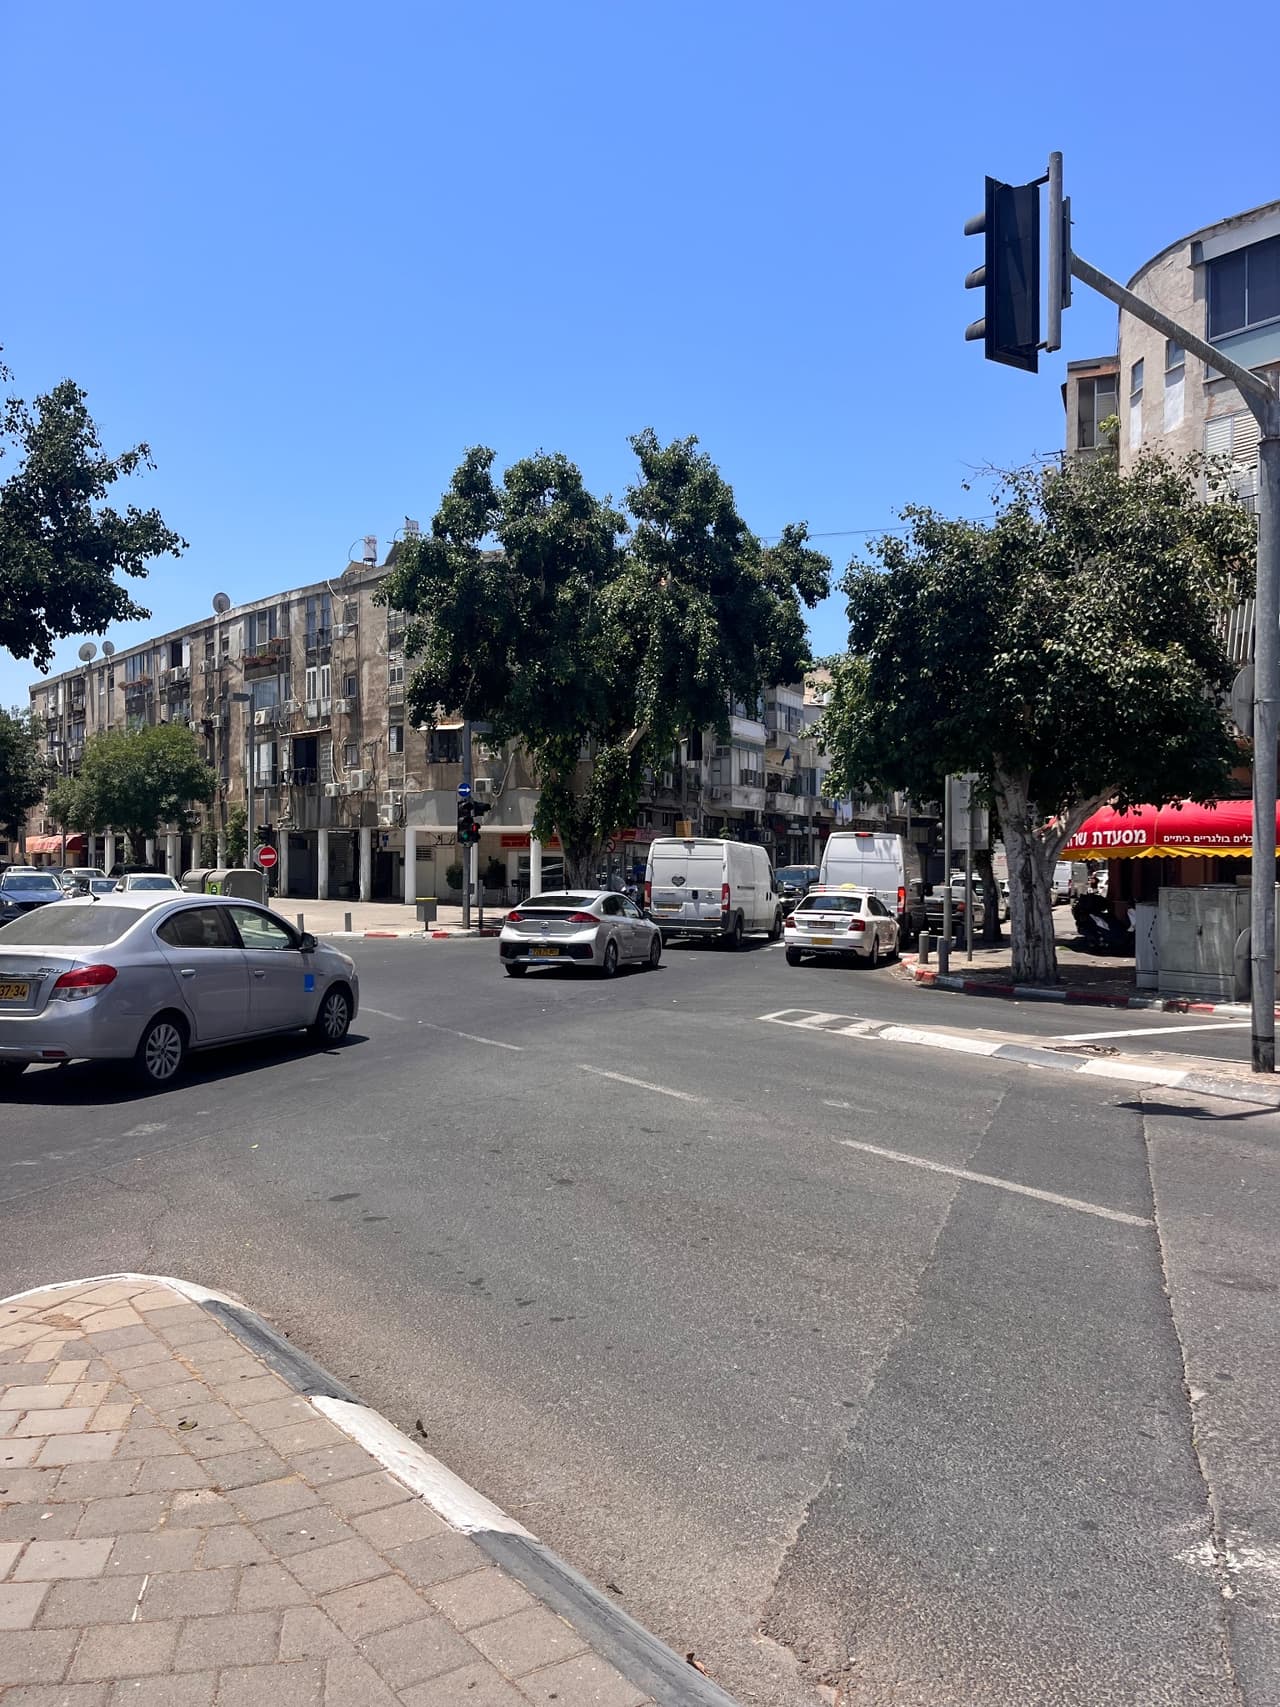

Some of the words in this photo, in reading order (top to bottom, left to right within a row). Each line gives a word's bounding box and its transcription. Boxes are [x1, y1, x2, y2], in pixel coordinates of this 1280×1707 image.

[1092, 829, 1147, 846] מסעדת
[1163, 834, 1191, 843] ביתיים
[1193, 833, 1231, 843] בולגריים
